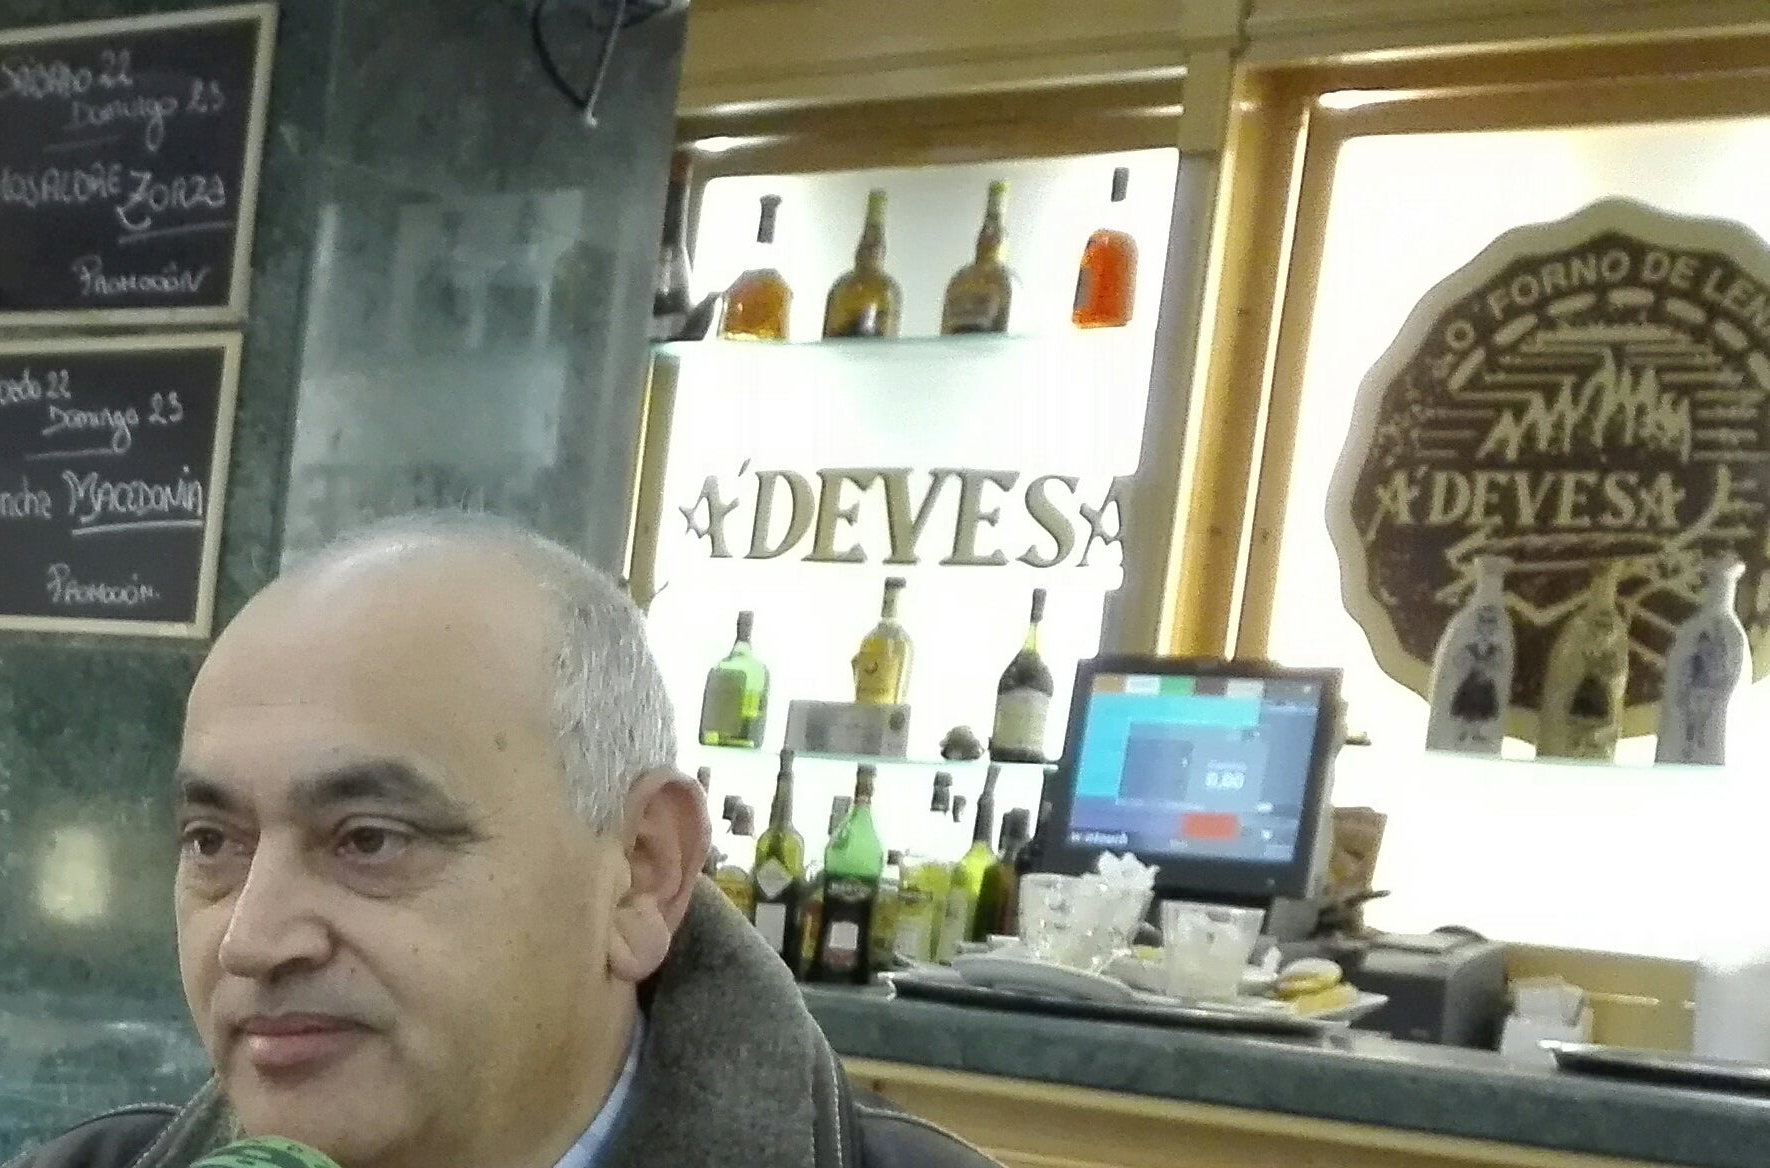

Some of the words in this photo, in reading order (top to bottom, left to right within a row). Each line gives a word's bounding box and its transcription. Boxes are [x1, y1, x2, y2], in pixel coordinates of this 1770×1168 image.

[98, 50, 133, 88] 22
[1486, 247, 1630, 319] FORNO
[1642, 250, 1701, 290] DE
